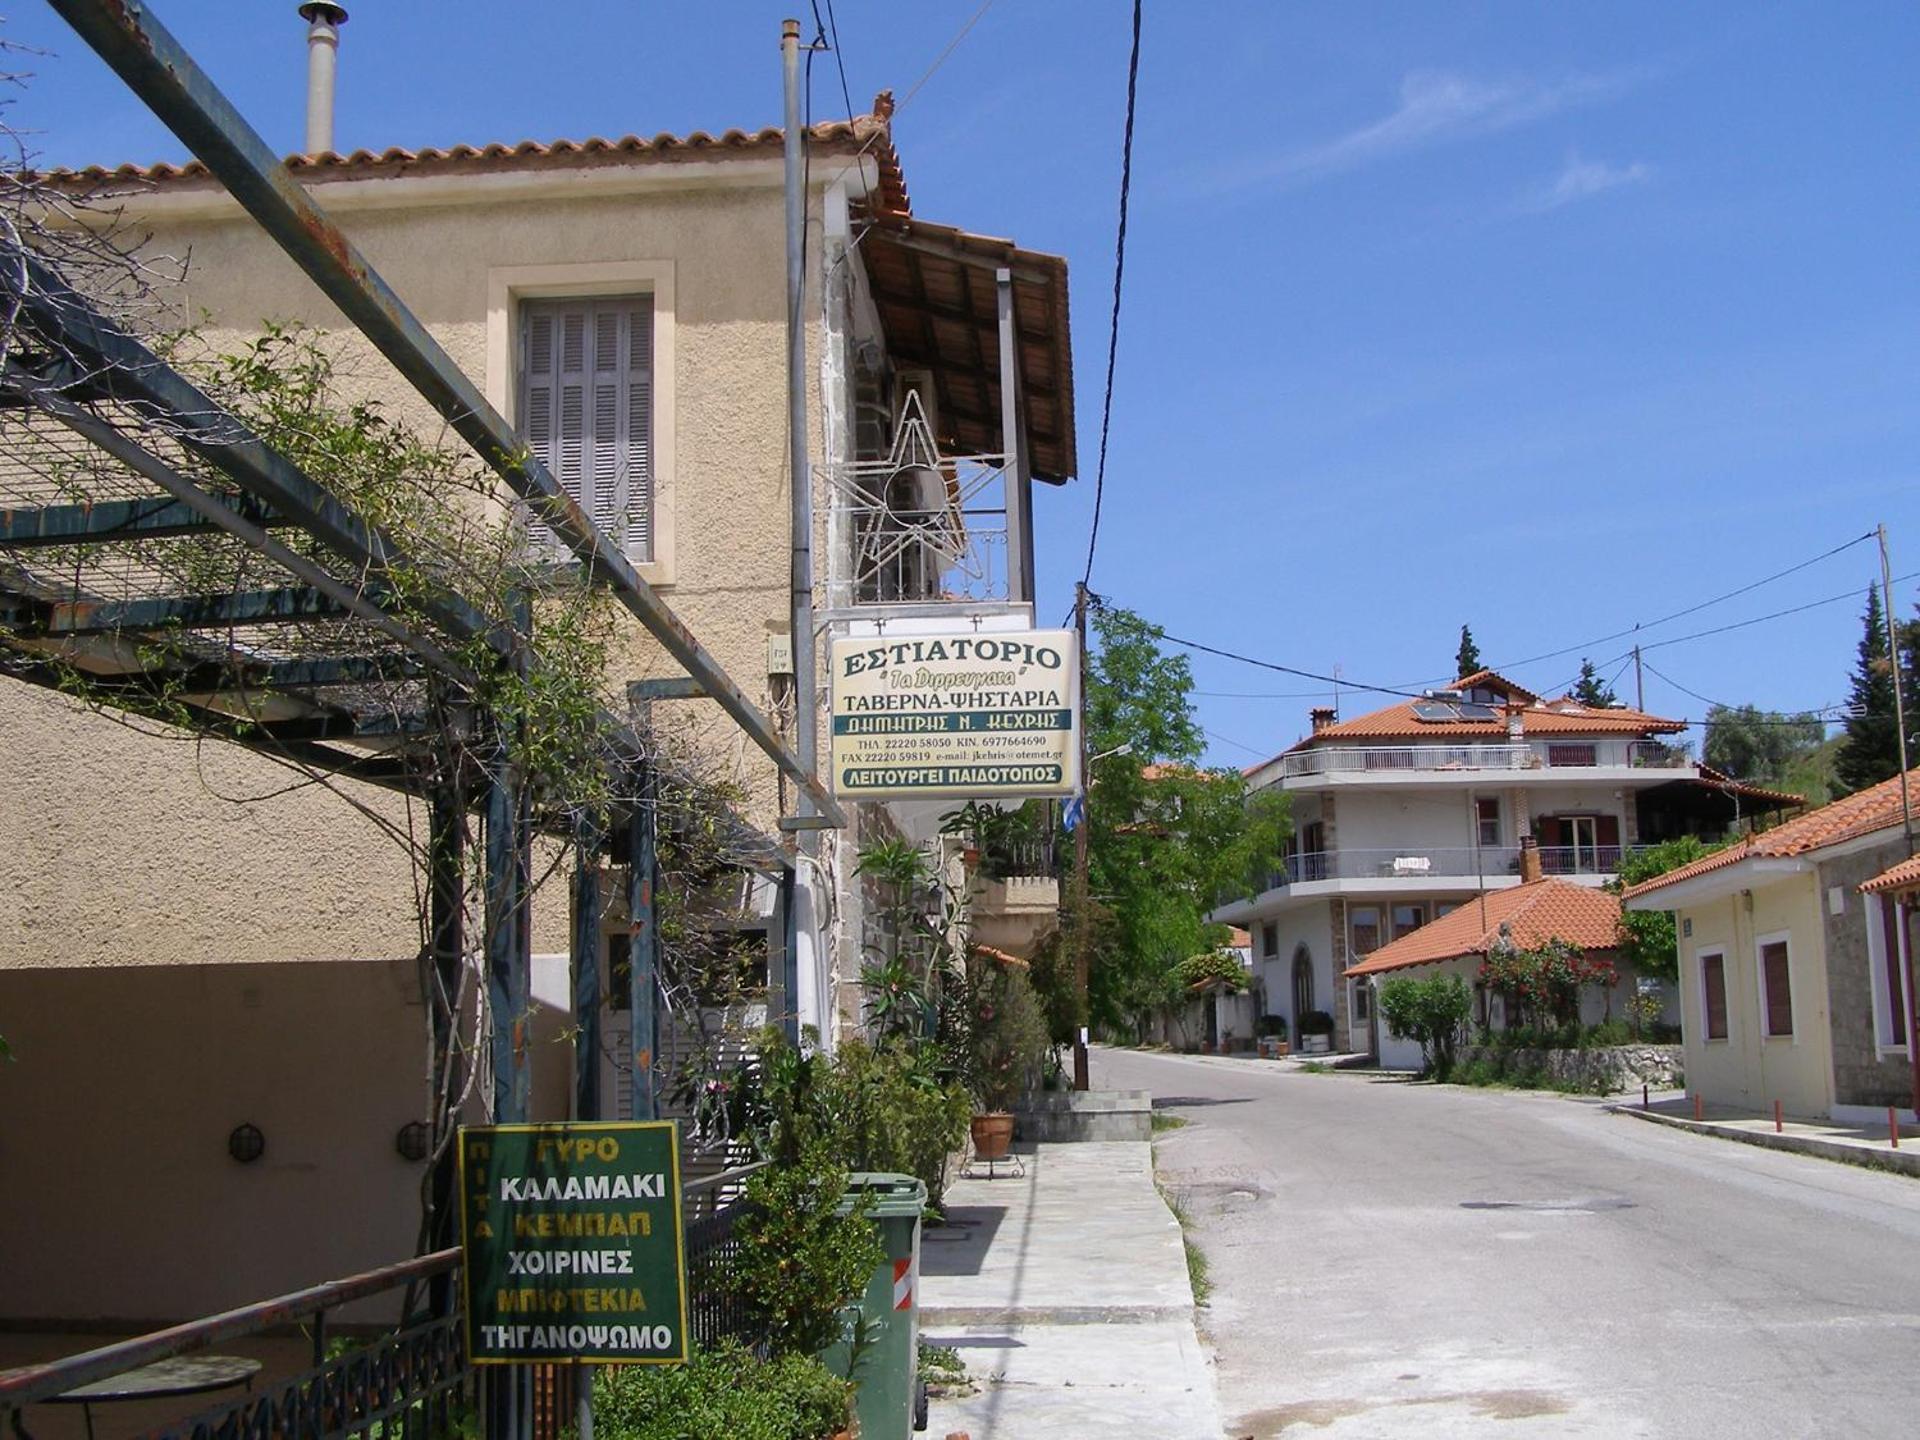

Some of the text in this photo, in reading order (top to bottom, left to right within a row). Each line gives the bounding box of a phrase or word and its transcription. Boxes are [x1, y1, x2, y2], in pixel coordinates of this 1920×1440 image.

[844, 639, 1061, 677] ΕΣΤΙΑΤΟΡΙΟ
[843, 690, 1060, 711] ΤΑΒΕΡΝΑ-ΨΗΣΤΑΡΙΑ
[846, 715, 948, 733] ΔΗΜΗΤΡΗΣ
[986, 712, 1059, 729] ΚΕΧΡΗΣ
[885, 739, 917, 749] 22220
[920, 738, 952, 748] 58050
[982, 736, 1047, 747] 6977664690
[864, 752, 896, 762] 22220
[899, 751, 931, 761] 59819
[849, 767, 1057, 785] ΛΕΙΤΟΥΡΓΕΙ ΠΑΙΔΟΤΟΠΟΣ
[536, 1137, 620, 1162] ΓΥΡΟ
[500, 1173, 666, 1201] ΚΑΛΑΜΑΚΙ
[515, 1212, 651, 1237] ΚΕΜΠΑΠ
[508, 1250, 634, 1274] ΧΟΙΡΙΝΕΣ
[497, 1288, 647, 1312] ΜΠΙΦΤΕΚΙΑ
[480, 1325, 673, 1350] ΤΗΓΑΝΟΨΩΜΟ
